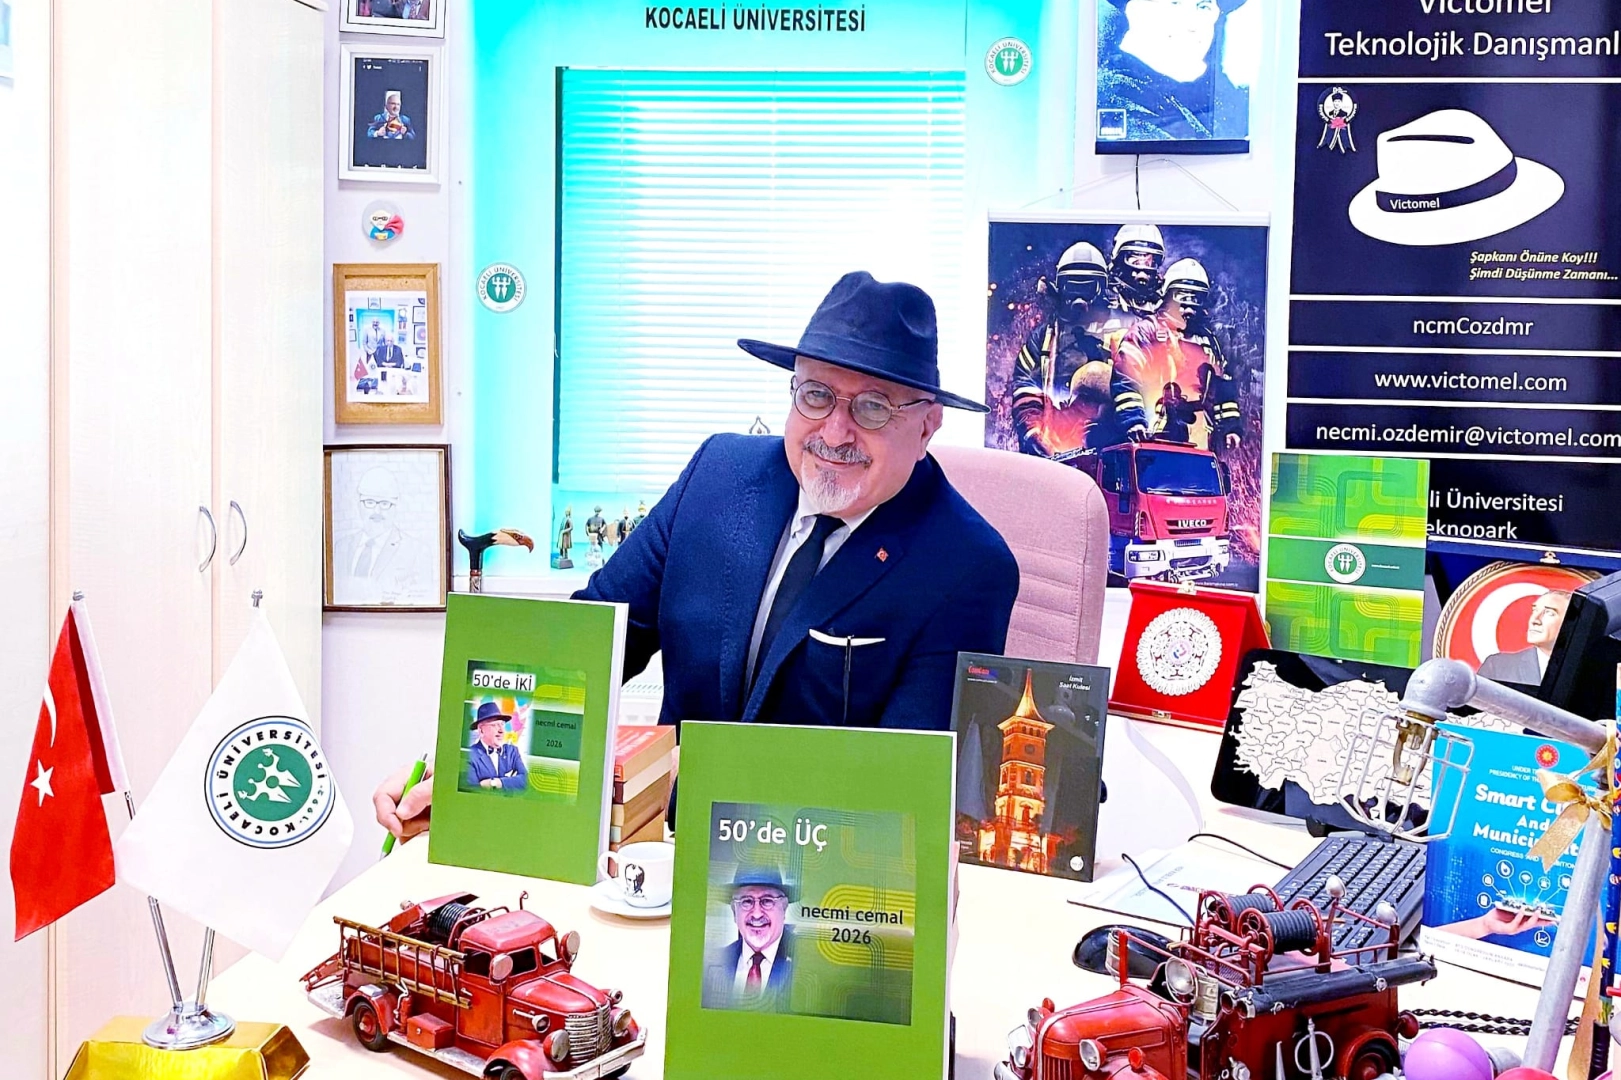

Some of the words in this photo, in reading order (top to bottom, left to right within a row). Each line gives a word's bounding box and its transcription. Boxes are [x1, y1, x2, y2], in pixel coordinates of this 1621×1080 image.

[645, 2, 726, 30] KOCAELİ
[733, 3, 865, 32] ÜNİVERSİTESİ
[1324, 30, 1464, 61] Teknolojik
[1389, 197, 1440, 210] Victomel
[1470, 250, 1517, 265] Şapkanı
[1519, 250, 1559, 263] Önüne
[1561, 252, 1598, 266] Koy!!!
[1469, 266, 1503, 281] Şimdi
[1504, 267, 1561, 281] Düşünme
[1562, 269, 1618, 281] Zamanı...
[1412, 317, 1534, 336] ncmCozdmr
[1374, 371, 1567, 391] www.victomel.com
[1316, 424, 1621, 448] necmi.ozdemir@victomel.com
[1446, 488, 1564, 512] Üniversitesi
[1178, 519, 1207, 528] IVECO
[1426, 518, 1518, 539] eknopark
[473, 673, 511, 689] 50'de
[515, 673, 532, 691] İKİ
[535, 719, 556, 728] necmi
[556, 721, 576, 730] cemal
[546, 739, 563, 748] 2026
[216, 729, 328, 779] ÜNİVERSİTESİ
[1512, 765, 1532, 774] UNDER
[1474, 783, 1537, 811] Smart
[1516, 814, 1551, 832] And
[795, 818, 828, 852] ÜÇ
[1490, 847, 1524, 859] CONGRESS
[801, 905, 850, 921] necmi
[855, 908, 904, 925] cemal
[831, 927, 872, 945] 2026
